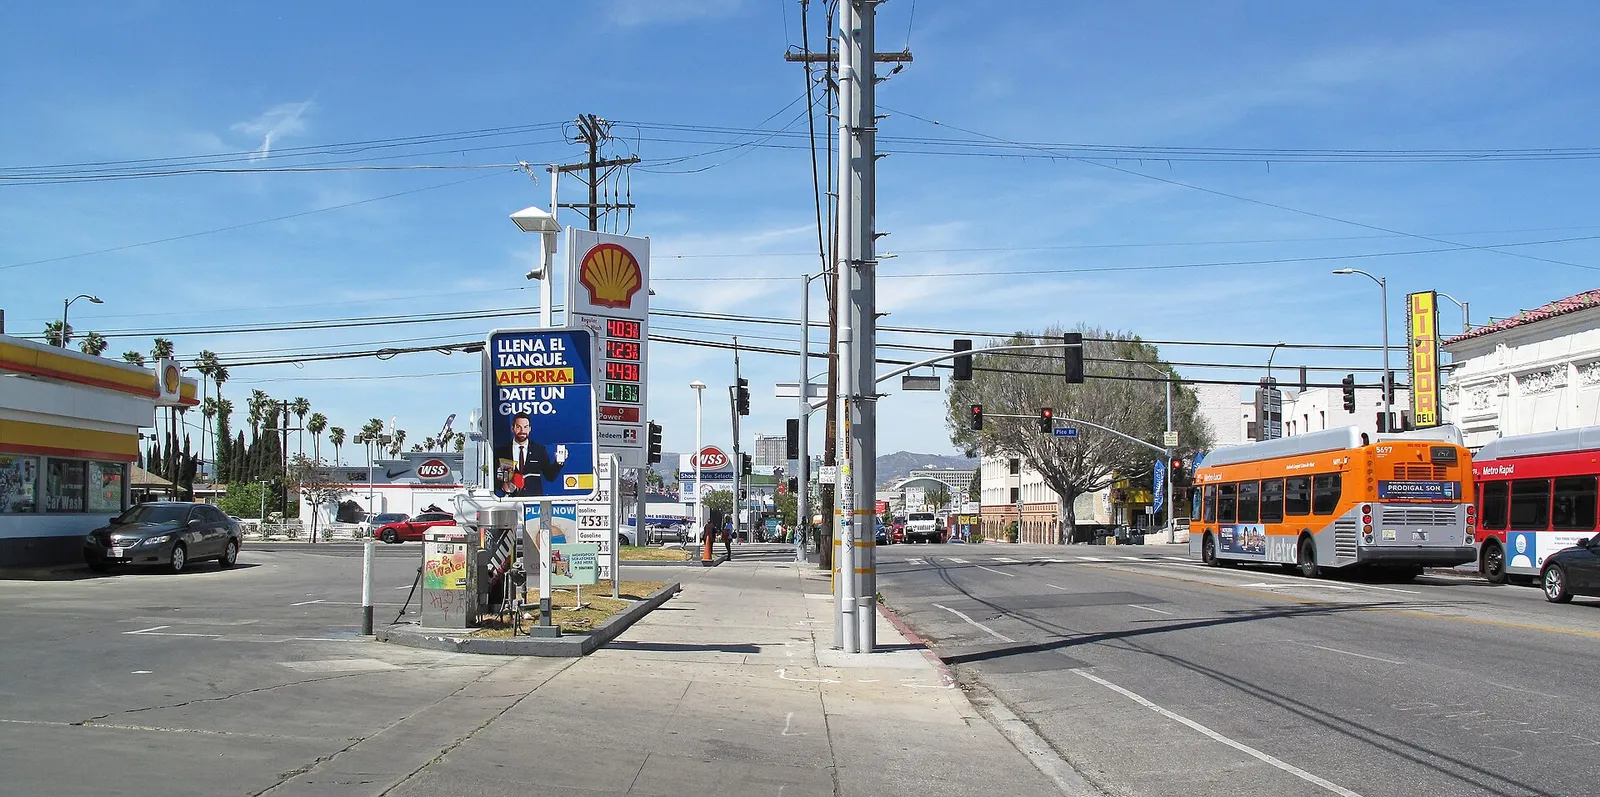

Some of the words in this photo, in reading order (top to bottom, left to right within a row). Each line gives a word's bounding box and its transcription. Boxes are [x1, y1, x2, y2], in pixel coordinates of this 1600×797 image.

[498, 338, 546, 353] LLENA
[550, 338, 565, 351] EL
[498, 353, 567, 367] TANQUE.
[1414, 296, 1432, 411] LIQUOR
[499, 369, 573, 384] AHORRA.
[607, 363, 632, 380] 4.43
[500, 387, 536, 401] DATE
[541, 386, 565, 400] UN
[499, 401, 557, 415] GUSTO.
[1417, 413, 1434, 423] DELI
[420, 465, 445, 475] WSS
[1483, 466, 1498, 475] Metro
[1499, 465, 1514, 476] Rapid
[46, 495, 59, 509] Car
[61, 495, 83, 509] Wash
[526, 506, 540, 514] PLA
[553, 506, 575, 515] NOW
[581, 516, 601, 527] 453
[1267, 537, 1297, 561] Metro
[442, 555, 450, 565] &
[433, 560, 466, 578] Water
